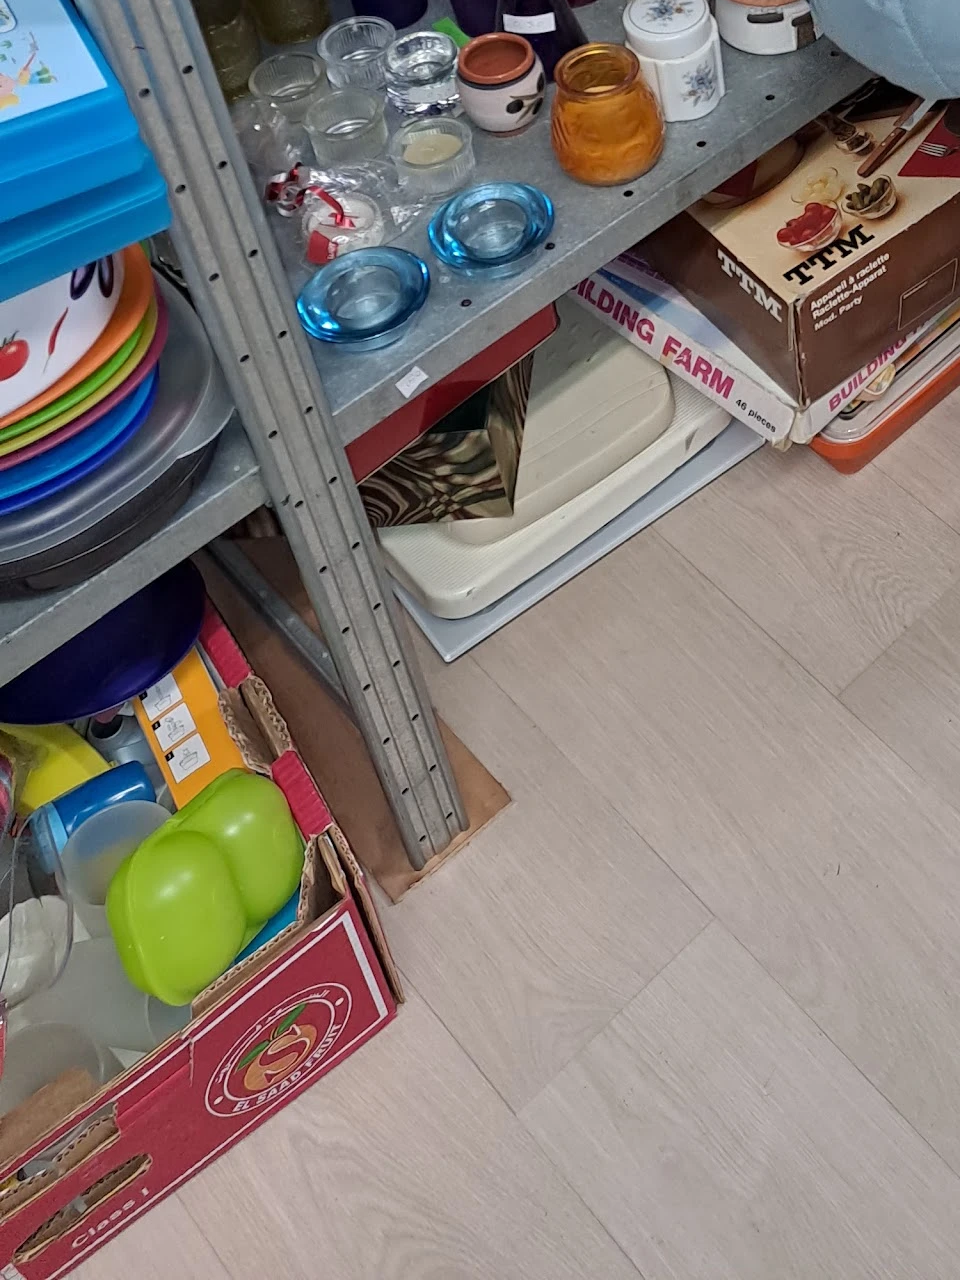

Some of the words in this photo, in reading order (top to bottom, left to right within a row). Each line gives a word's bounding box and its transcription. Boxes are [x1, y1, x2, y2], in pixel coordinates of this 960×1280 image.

[783, 224, 875, 286] TTM
[811, 279, 848, 311] Appareil
[856, 253, 890, 280] raclette
[717, 248, 783, 323] TTM
[814, 312, 838, 331] Mod.
[839, 295, 863, 316] Party
[662, 335, 735, 400] FARM
[735, 399, 747, 411] 46
[747, 409, 777, 434] pieces
[232, 1100, 250, 1113] EL
[256, 1070, 302, 1105] SAAD
[304, 1023, 342, 1068] FRUIT
[71, 1199, 136, 1249] Class
